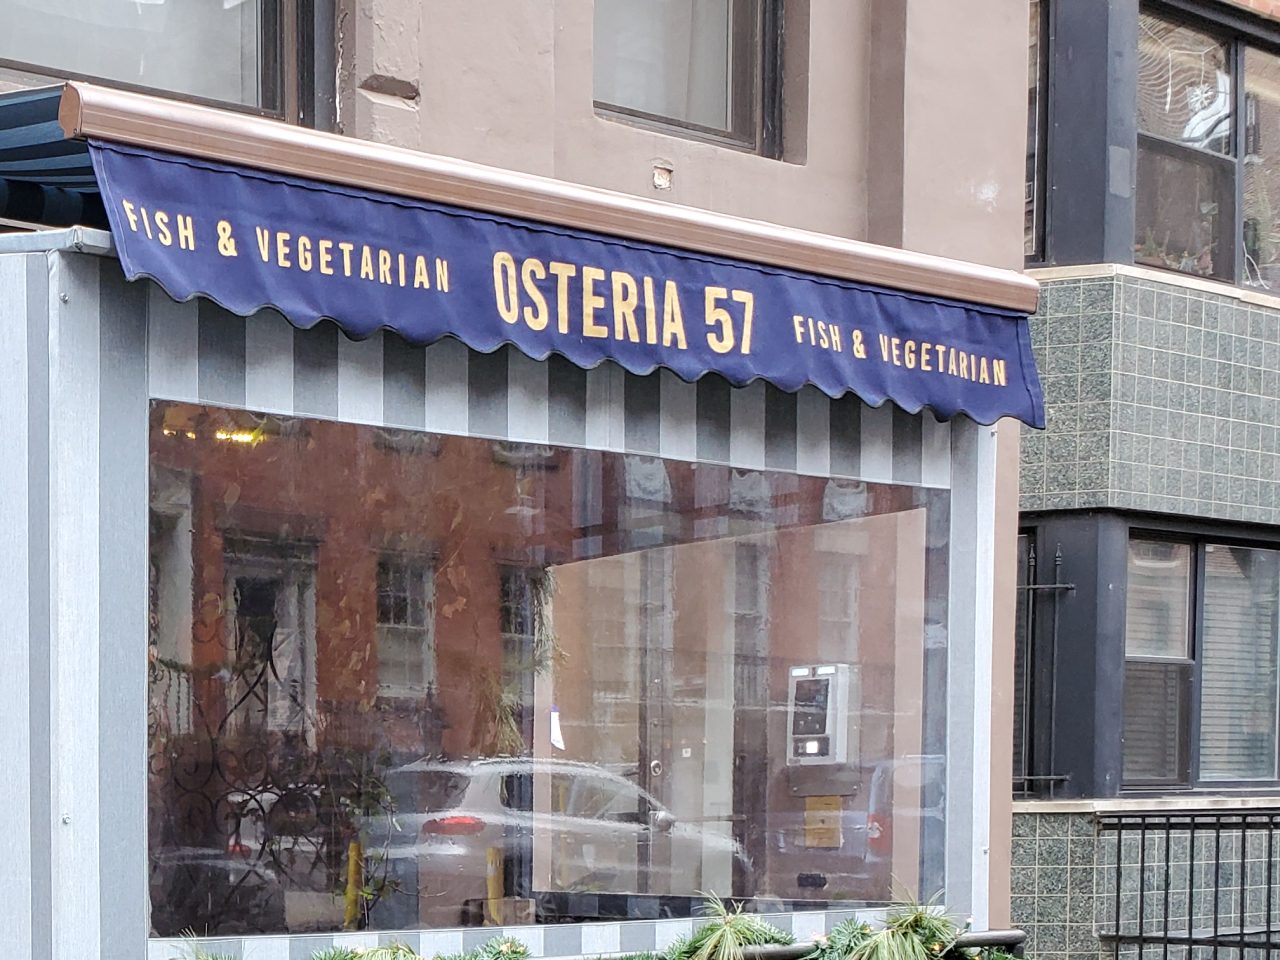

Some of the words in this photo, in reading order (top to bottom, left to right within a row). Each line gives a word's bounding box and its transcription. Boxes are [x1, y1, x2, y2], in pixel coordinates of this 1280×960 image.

[122, 199, 195, 251] FISH
[216, 220, 238, 257] &
[255, 226, 449, 293] VEGETARIAN
[493, 251, 688, 350] OSTERIA
[704, 286, 754, 354] 57
[792, 315, 842, 353] FISH
[852, 329, 867, 359] &
[879, 333, 1007, 387] VEGETARIAN
